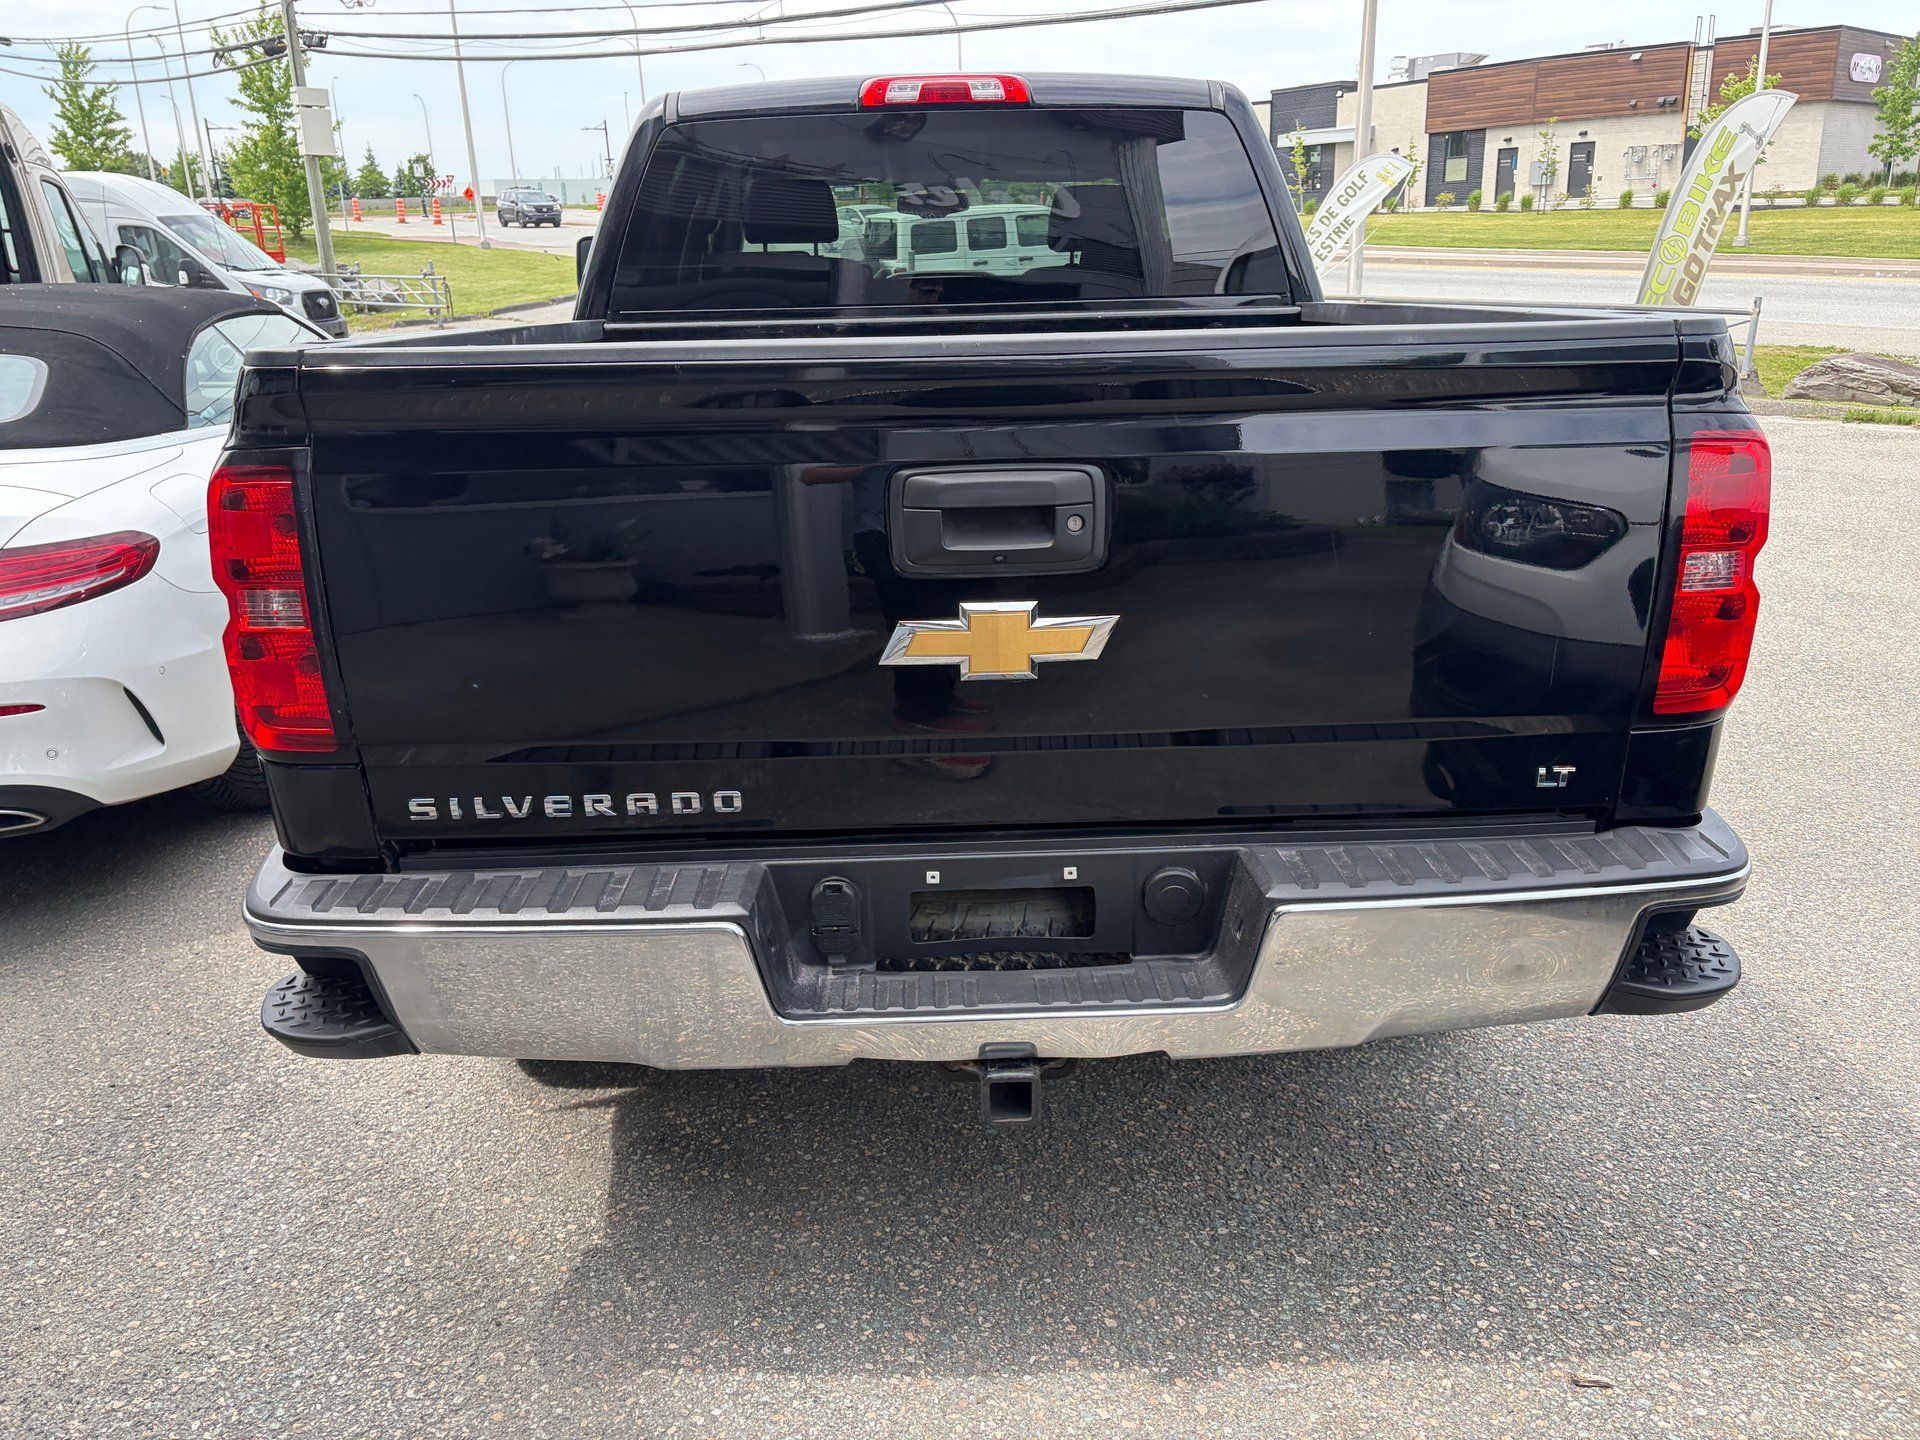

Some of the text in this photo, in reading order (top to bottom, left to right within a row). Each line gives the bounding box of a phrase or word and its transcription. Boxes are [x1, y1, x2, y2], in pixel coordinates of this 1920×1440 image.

[1319, 206, 1339, 227] DE
[1337, 170, 1368, 207] GOLF
[1536, 767, 1576, 787] LT
[408, 790, 743, 821] SILVERADO
